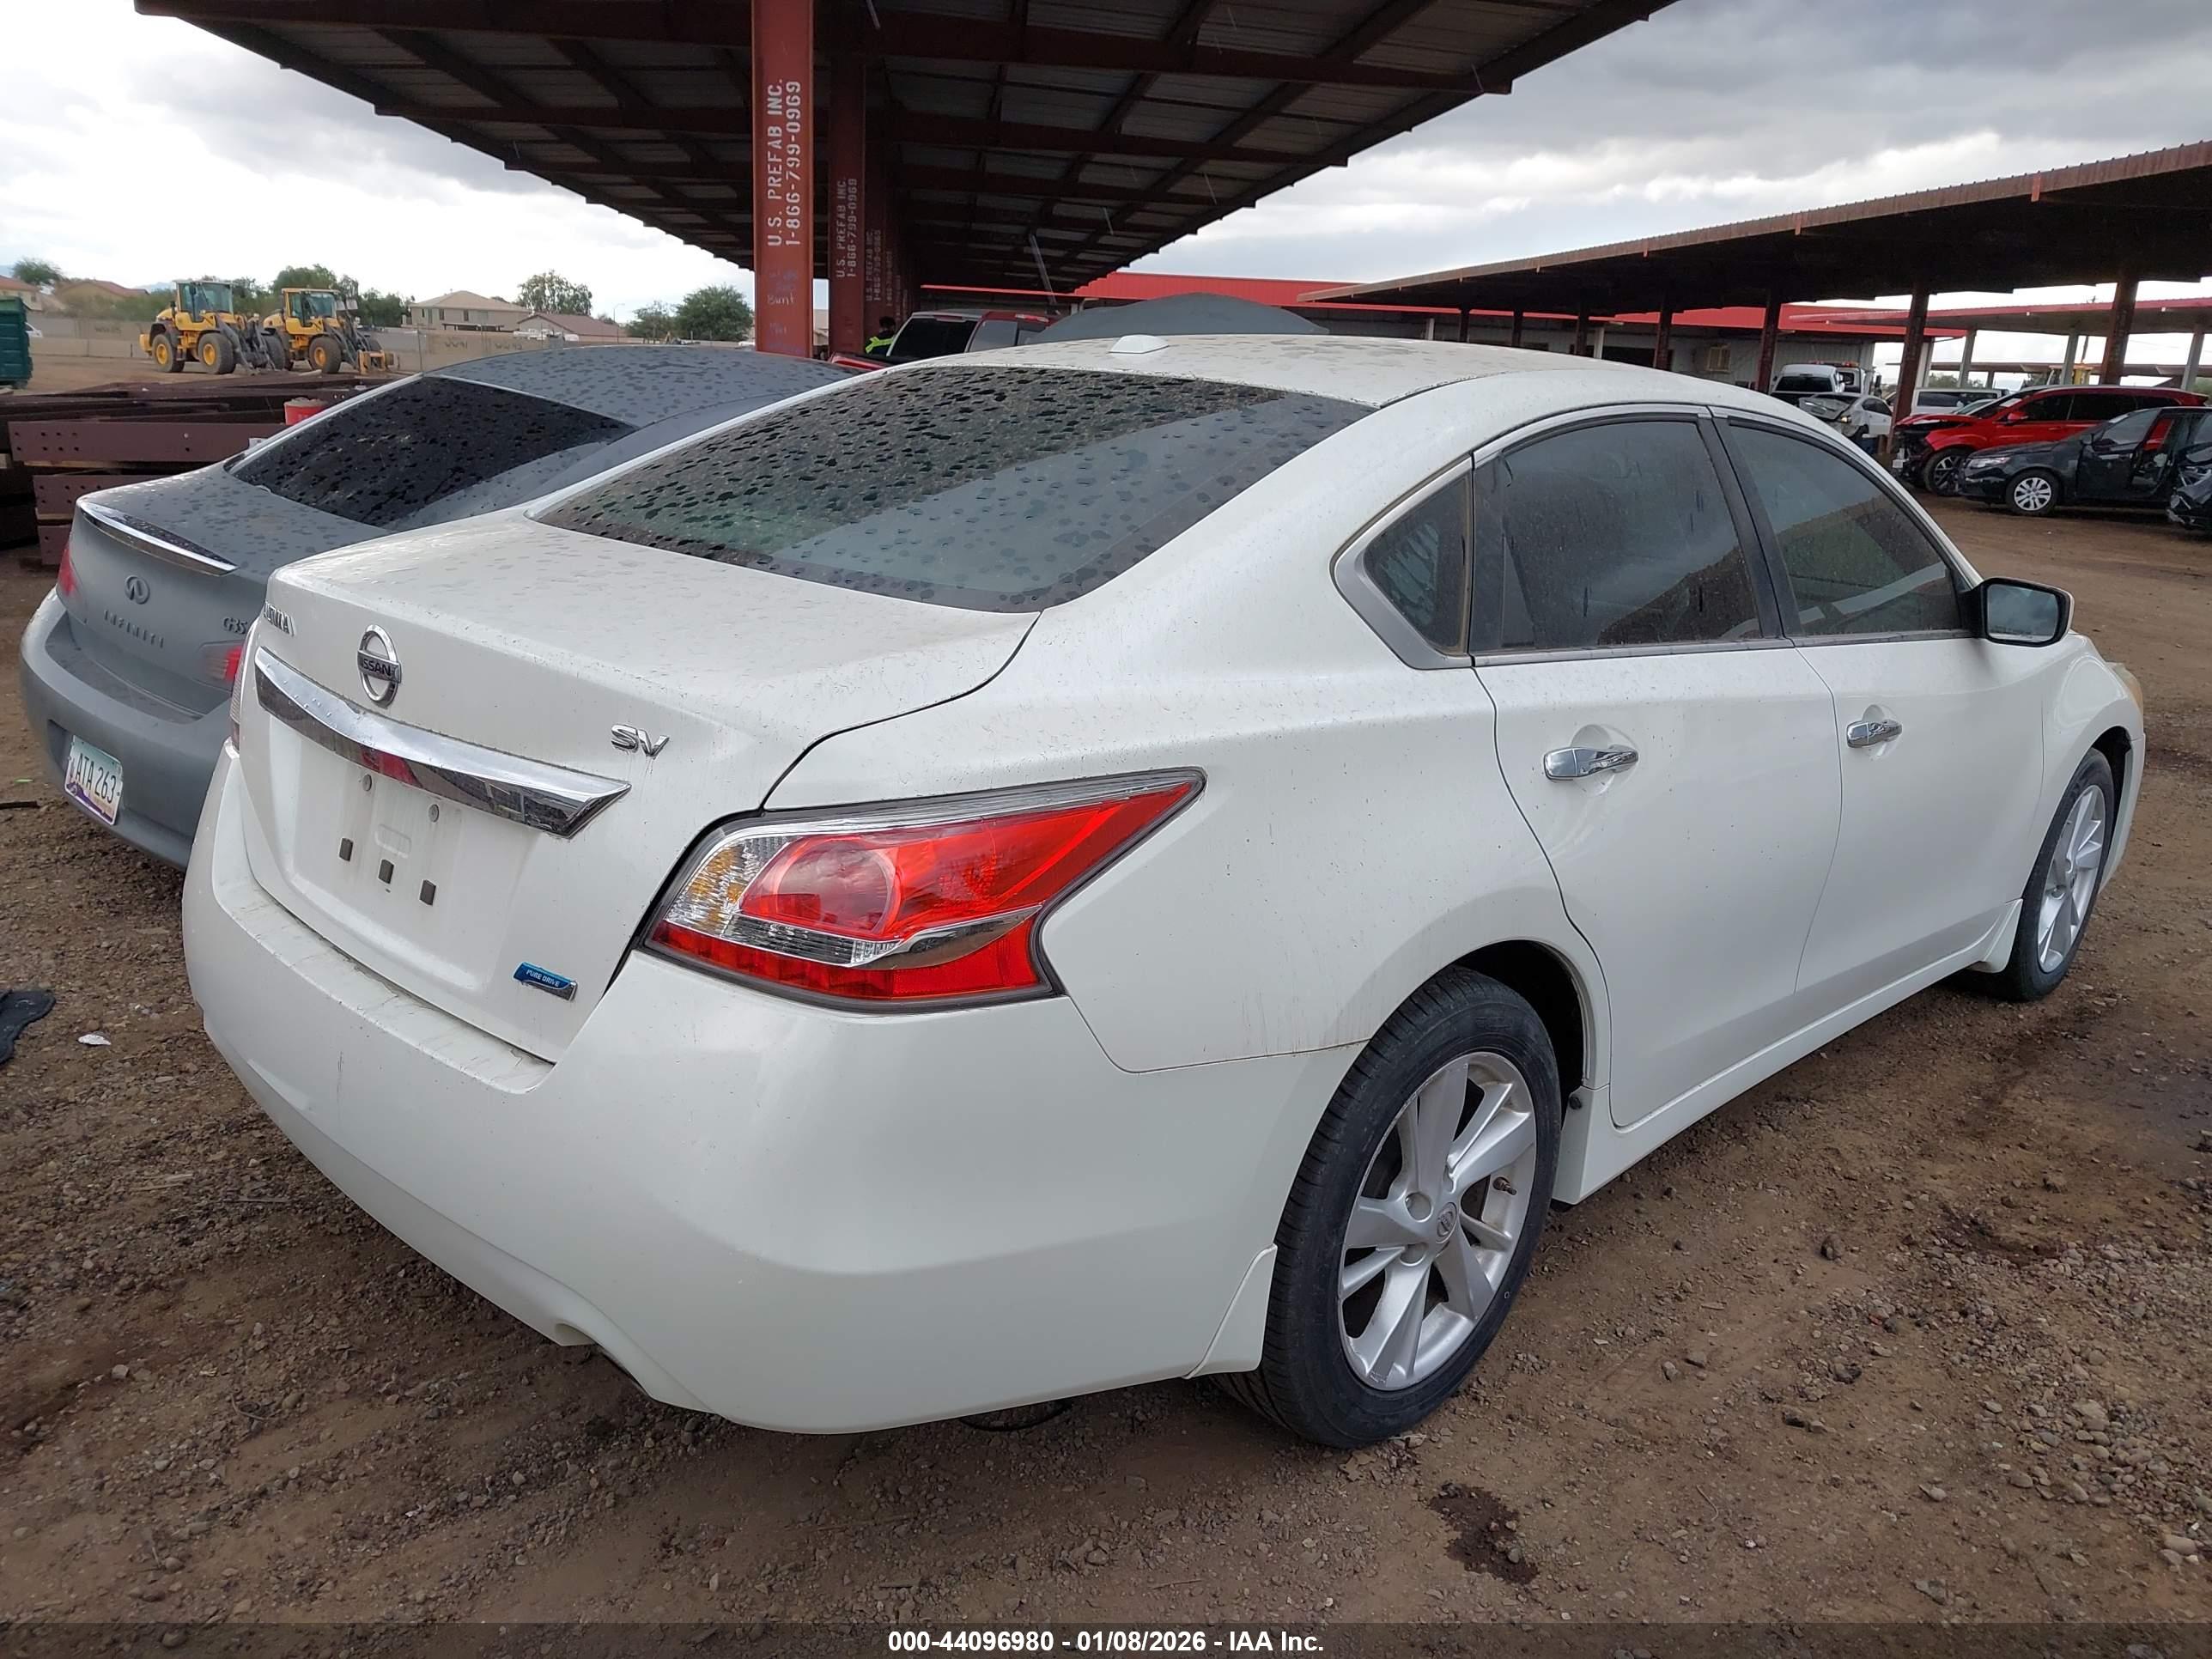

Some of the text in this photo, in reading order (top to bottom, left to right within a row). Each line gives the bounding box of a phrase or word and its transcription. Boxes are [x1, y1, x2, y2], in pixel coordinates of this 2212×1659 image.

[767, 78, 783, 246] U.S. PREFAB INC.
[785, 81, 801, 246] 1-866-799-0969
[836, 204, 846, 250] PREFAB
[611, 724, 670, 761] SV
[526, 969, 561, 988] PURE DRIVE
